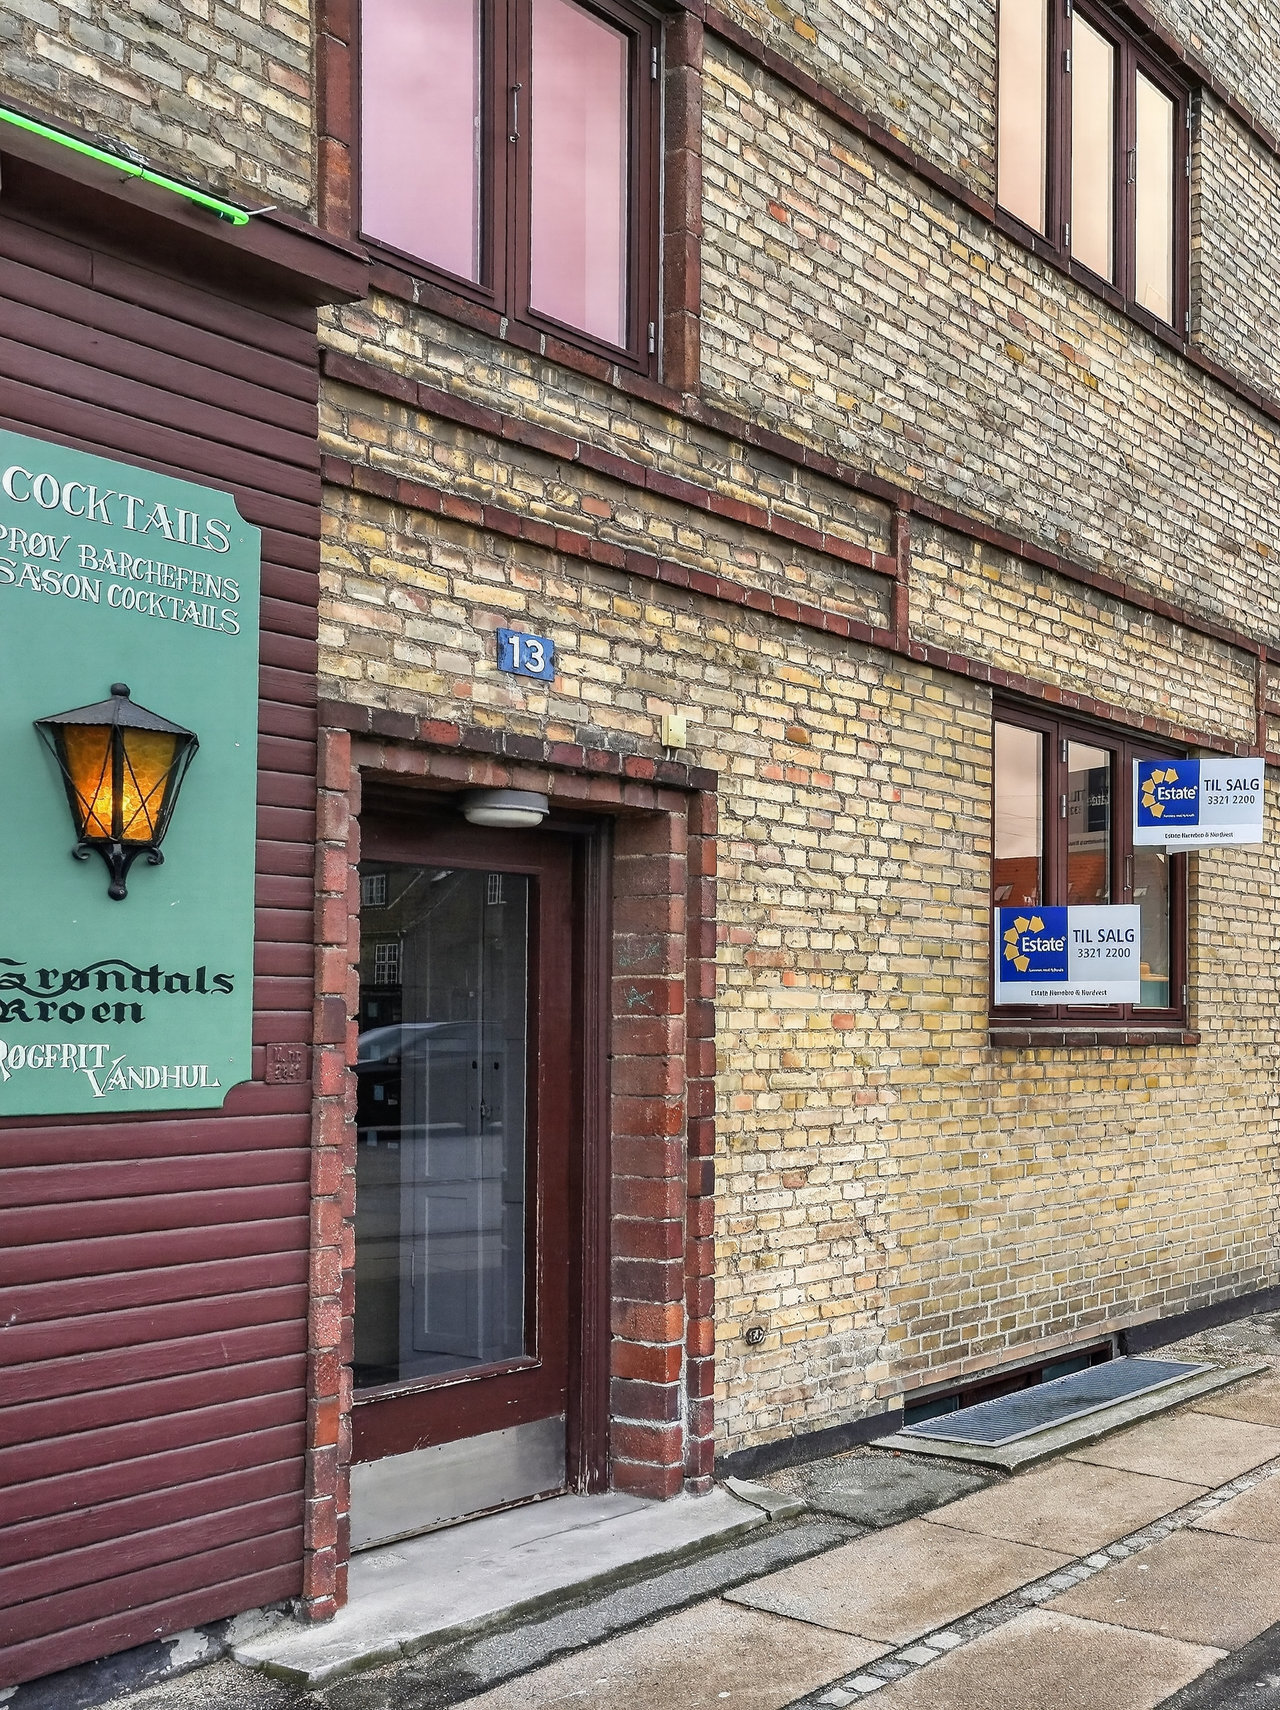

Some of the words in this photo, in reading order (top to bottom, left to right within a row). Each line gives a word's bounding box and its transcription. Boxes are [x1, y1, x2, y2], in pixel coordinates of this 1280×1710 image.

[2, 465, 232, 553] COCKTAILS
[78, 544, 241, 603] BARCHEFENS
[107, 583, 240, 635] COCKTAILS
[508, 636, 546, 673] 13
[1203, 779, 1222, 791] TIL
[1226, 778, 1260, 791] SALG
[1157, 786, 1196, 801] Estate
[1207, 796, 1229, 805] 3321
[1232, 794, 1255, 804] 2200
[1073, 929, 1093, 943] TIL
[1097, 928, 1135, 943] SALG
[1022, 936, 1064, 952] Estate
[1077, 948, 1101, 958] 3321
[1105, 947, 1131, 957] 2200
[85, 1054, 221, 1098] VANDHUL
